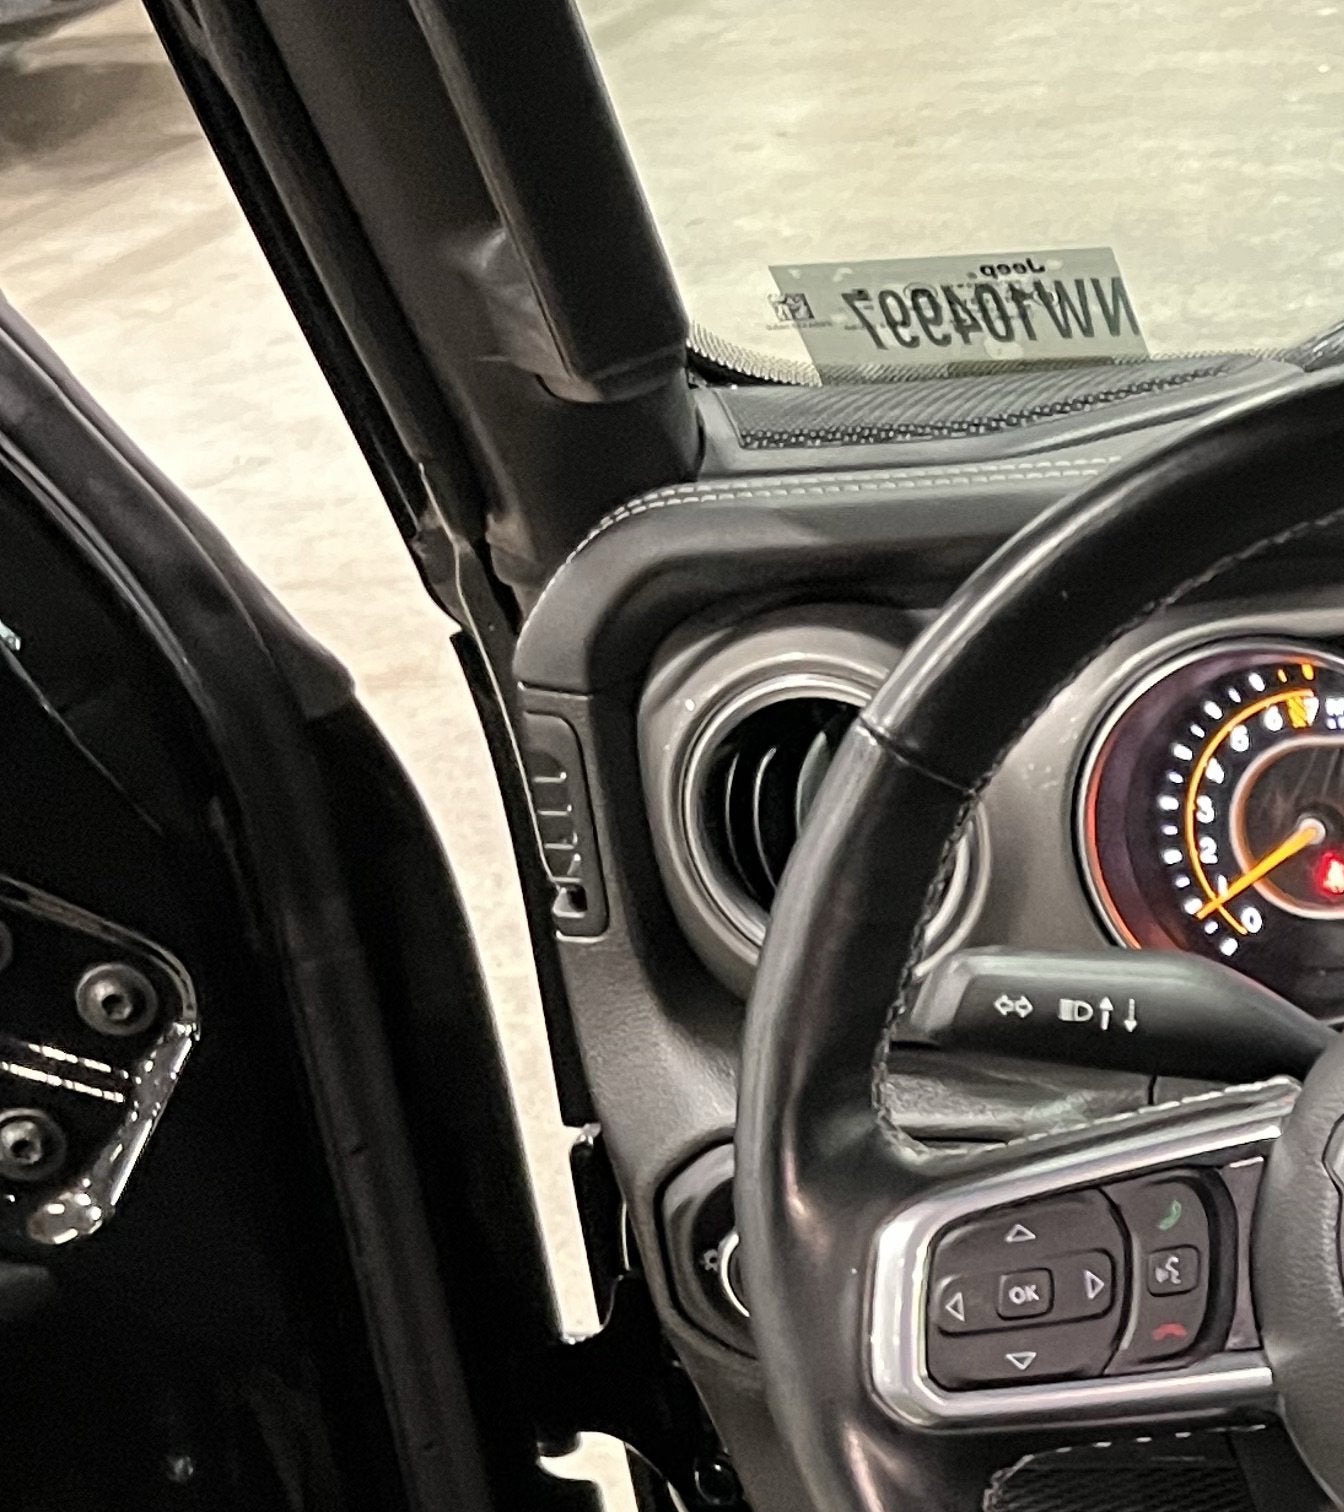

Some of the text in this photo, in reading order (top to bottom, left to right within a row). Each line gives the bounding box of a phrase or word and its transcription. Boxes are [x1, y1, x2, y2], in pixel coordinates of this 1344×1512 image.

[1199, 836, 1218, 864] 2
[1240, 906, 1263, 934] 0
[1008, 1283, 1040, 1305] OK
